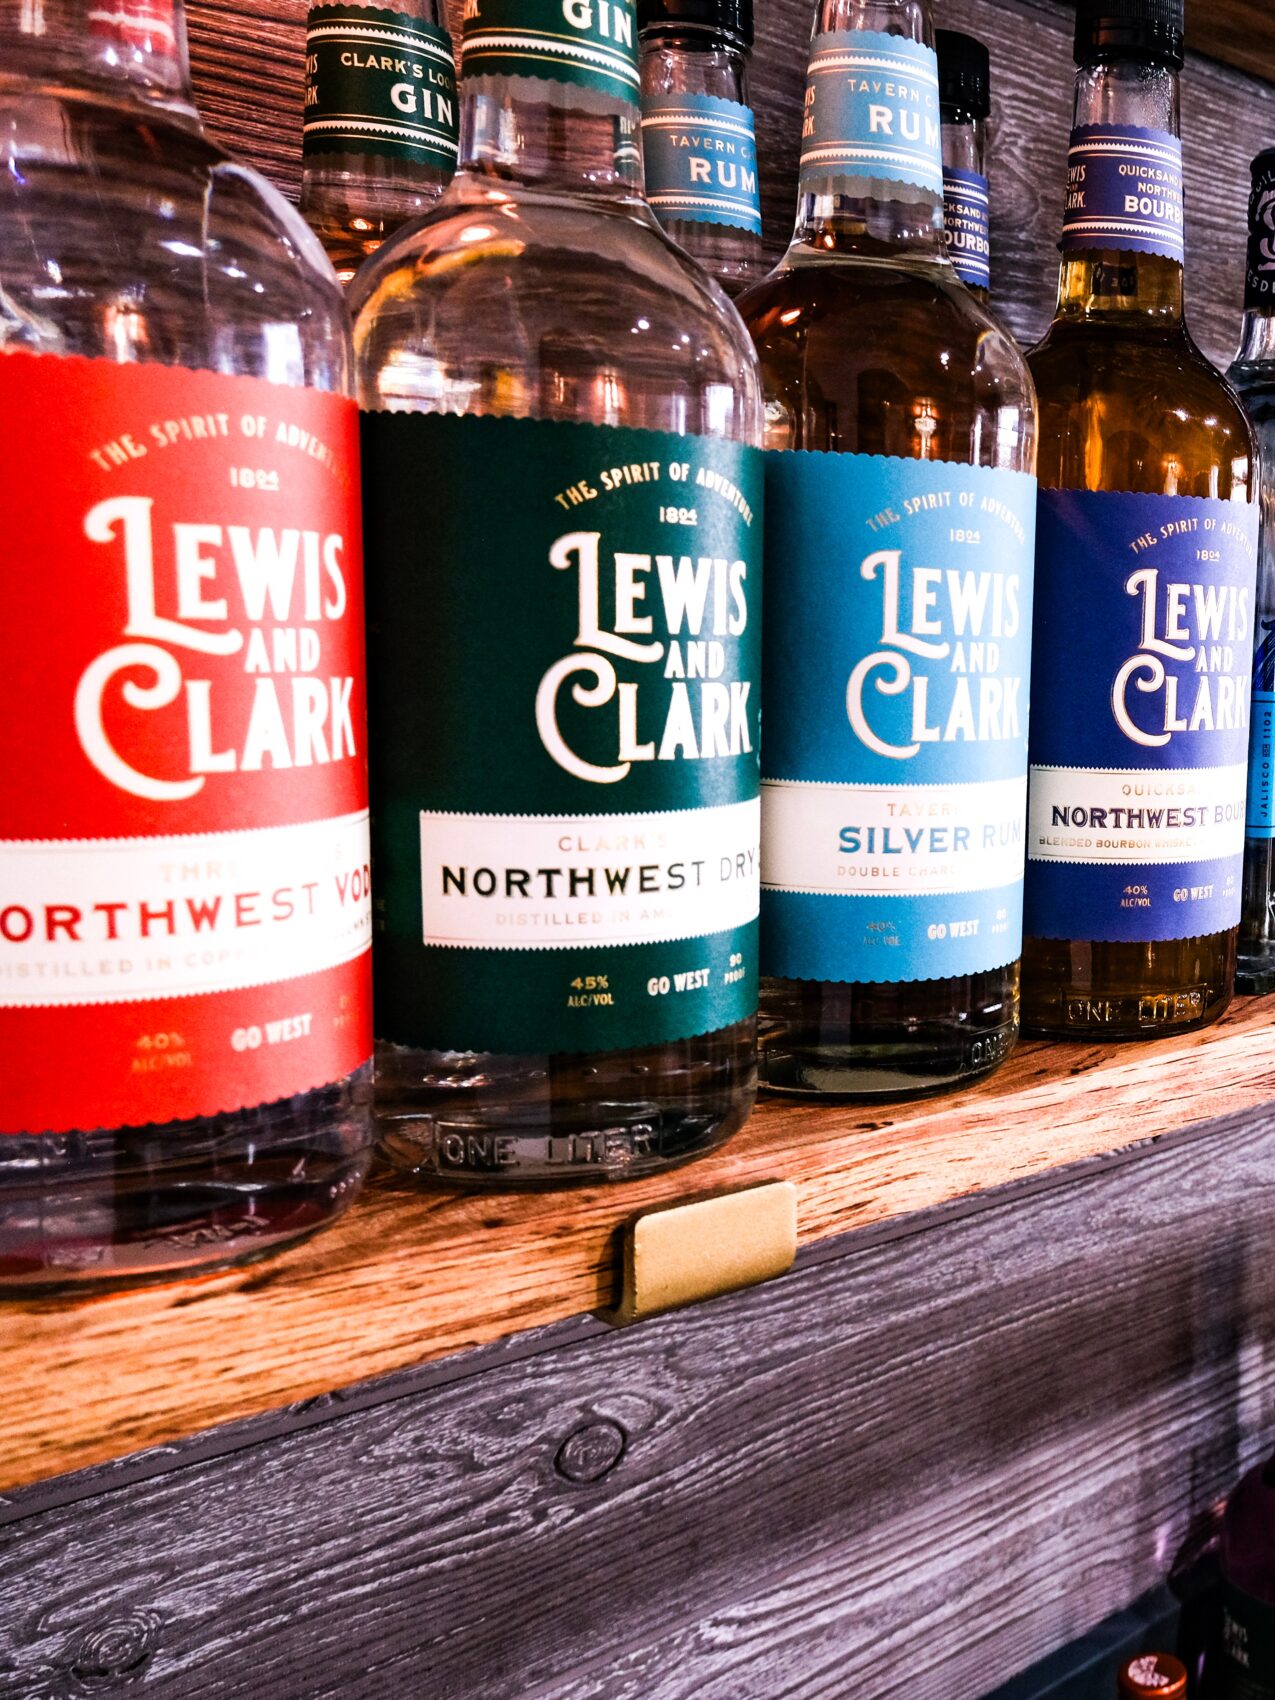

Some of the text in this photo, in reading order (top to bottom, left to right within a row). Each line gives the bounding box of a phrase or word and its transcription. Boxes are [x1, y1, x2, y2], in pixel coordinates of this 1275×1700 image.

[562, 0, 632, 49] GIN
[340, 52, 423, 79] CLARK'S
[390, 82, 453, 127] GIN
[847, 78, 919, 102] TAVERN
[670, 134, 736, 154] TAVERN
[868, 103, 939, 150] RUM
[688, 156, 756, 195] RUM
[89, 413, 268, 472] THE SPIRIT OF
[554, 479, 598, 510] THE
[600, 461, 660, 491] SPIRIT
[669, 462, 691, 482] OF
[659, 505, 698, 525] 1804
[866, 507, 900, 533] THE
[903, 491, 952, 515] SPIRIT
[960, 492, 976, 507] OF
[950, 528, 981, 544] 1804
[1129, 532, 1158, 555] THE
[1160, 518, 1199, 539] SPIRIT
[1204, 518, 1217, 531] OF
[1196, 549, 1221, 562] 1804
[83, 495, 347, 656] LEWIS
[548, 531, 748, 664] LEWIS
[860, 549, 1020, 660] LEWIS
[1124, 567, 1249, 662] LEWIS
[245, 628, 321, 675] AND
[663, 640, 725, 679] AND
[950, 642, 1000, 674] AND
[1195, 645, 1234, 673] AND
[535, 651, 754, 784] CLARK
[845, 650, 1021, 760] CLARK
[1111, 653, 1249, 748] CLARK
[73, 642, 357, 802] CLARK
[1263, 711, 1272, 739] 1102
[1260, 762, 1270, 818] JALISCO
[837, 816, 1022, 855] SILVER RUM
[1051, 805, 1207, 830] NORTHWEST
[1039, 835, 1092, 848] BLENDED
[1096, 838, 1151, 849] BOURBON
[441, 846, 756, 899] NORTHWEST DRY
[837, 865, 900, 878] DOUBLE
[1123, 884, 1148, 895] 40%
[1120, 898, 1151, 908] ALC/VOL
[1173, 884, 1214, 903] GO WEST
[496, 911, 602, 927] DISTILLED
[927, 923, 947, 940] GO
[949, 919, 980, 938] WEST
[147, 956, 173, 973] IN
[729, 952, 742, 967] 90
[567, 992, 614, 1008] ALC/VOL
[570, 974, 609, 990] 45%
[647, 967, 711, 997] GO WEST
[230, 1012, 313, 1053] GO WEST
[443, 1123, 654, 1166] ONE LITER
